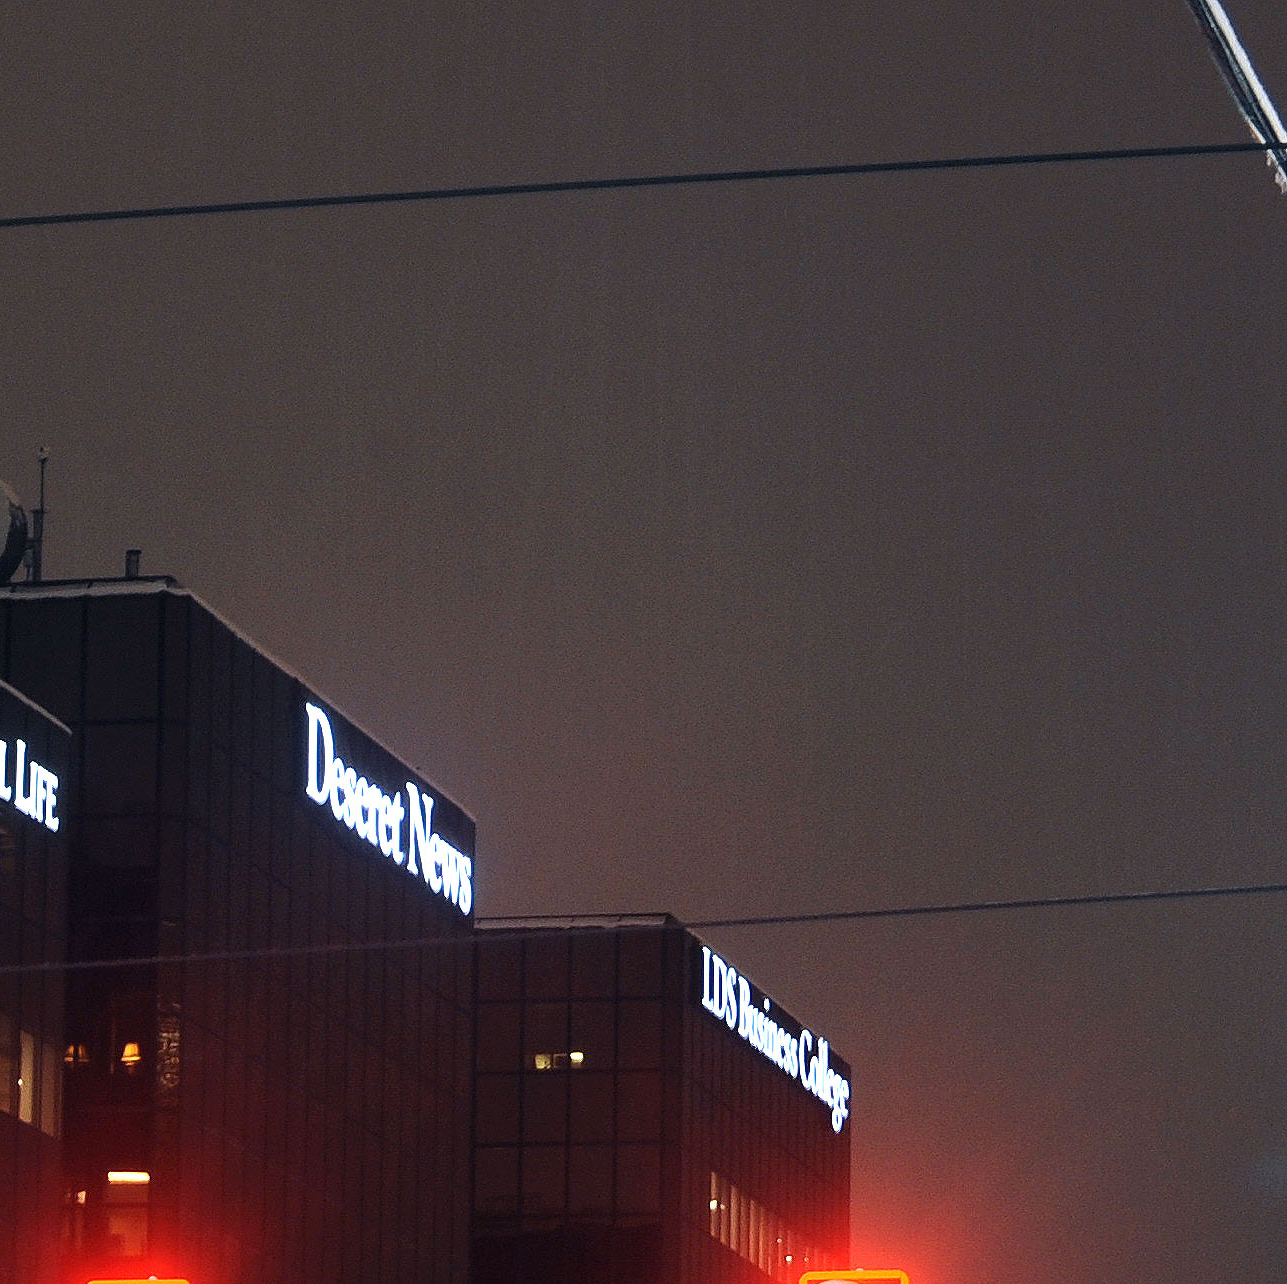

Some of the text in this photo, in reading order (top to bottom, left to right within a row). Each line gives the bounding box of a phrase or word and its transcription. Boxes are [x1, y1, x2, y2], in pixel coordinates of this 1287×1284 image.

[14, 738, 60, 833] LIFE
[305, 702, 472, 915] Deseret News
[702, 946, 850, 1133] LDS Business College
